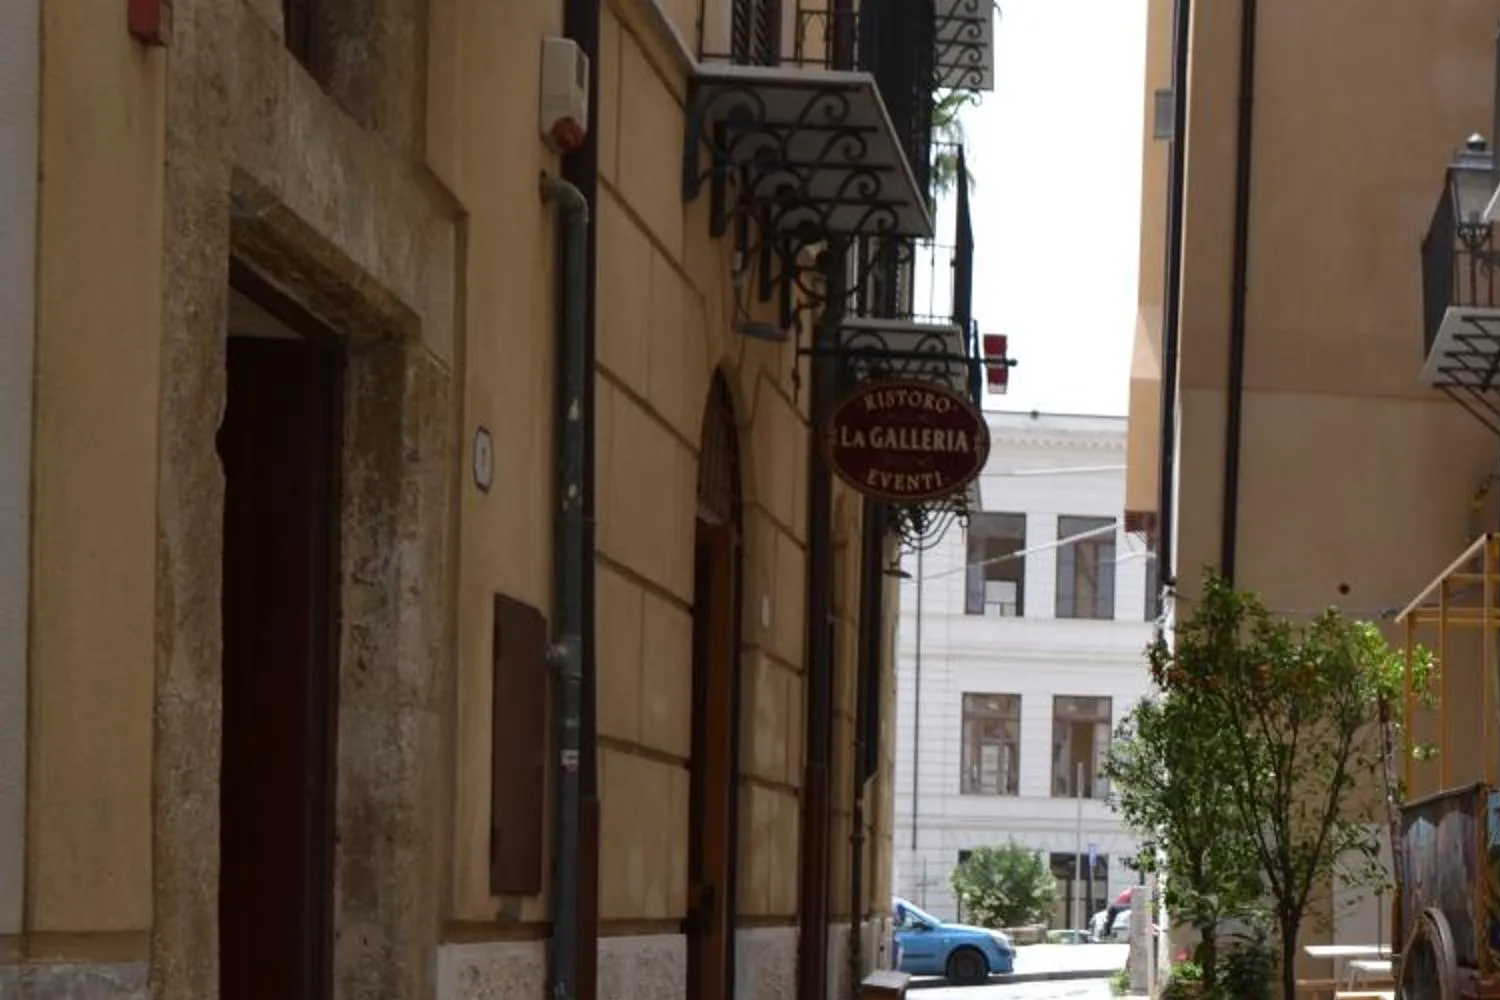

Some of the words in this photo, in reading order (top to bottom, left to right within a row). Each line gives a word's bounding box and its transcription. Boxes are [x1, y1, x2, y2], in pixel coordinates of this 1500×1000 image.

[863, 388, 951, 414] RISTORO
[868, 425, 969, 453] GALLERIA
[867, 468, 943, 491] EVENTI
